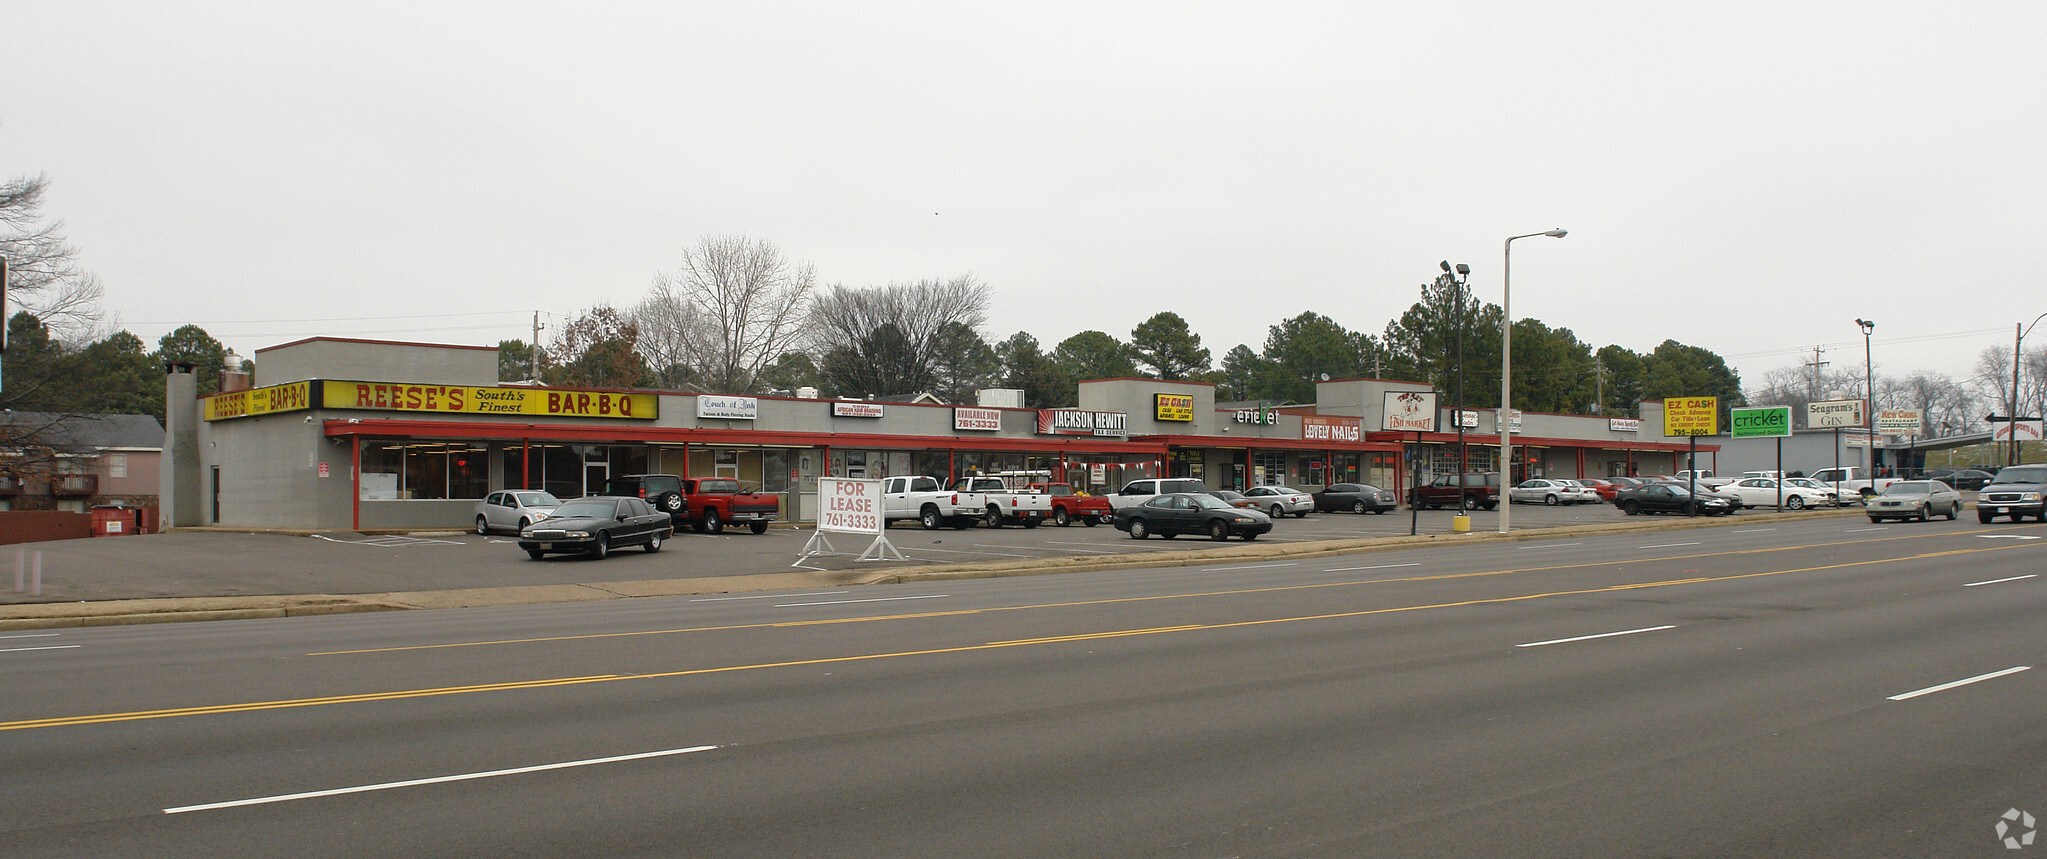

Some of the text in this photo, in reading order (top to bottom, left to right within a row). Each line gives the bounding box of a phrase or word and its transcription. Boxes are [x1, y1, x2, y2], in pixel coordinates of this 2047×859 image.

[252, 391, 267, 401] South's
[357, 384, 464, 410] REESE'S
[475, 389, 525, 401] South's
[1159, 397, 1170, 406] EZ
[214, 393, 246, 417] REESE'S
[253, 403, 266, 412] Finest
[477, 401, 522, 412] Finest
[701, 396, 726, 408] Touch
[1668, 401, 1682, 409] EZ
[1810, 403, 1853, 414] Seagram's
[957, 410, 999, 420] AVAILABLE NOW
[1054, 411, 1127, 429] JACKSON HEWITT
[1232, 402, 1279, 425] cricket
[1735, 410, 1784, 427] cricket
[958, 420, 998, 428] 761-3333
[1390, 416, 1431, 430] FISH MARKET
[1305, 424, 1359, 441] LOVELY NAILS
[836, 481, 865, 496] FOR
[830, 497, 872, 512] LEASE
[826, 512, 876, 529] 761-3333
